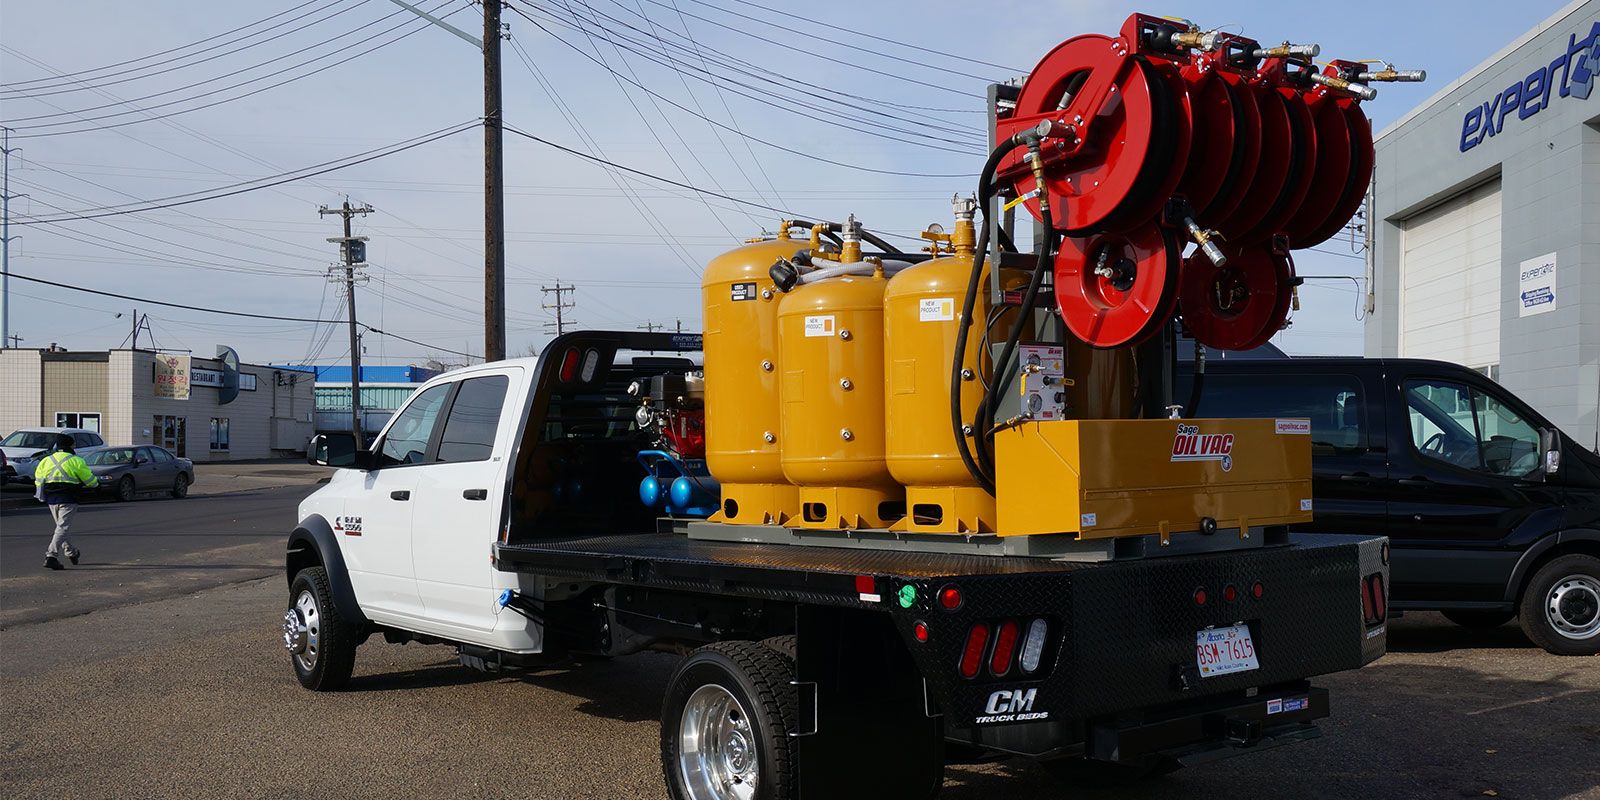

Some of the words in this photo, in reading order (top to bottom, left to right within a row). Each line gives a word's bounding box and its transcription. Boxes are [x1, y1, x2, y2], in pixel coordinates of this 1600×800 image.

[1177, 424, 1198, 435] Sage
[1172, 435, 1198, 455] OIL
[1200, 434, 1234, 455] VAC
[985, 688, 1038, 714] CM
[975, 714, 1016, 724] TRUCK
[1016, 711, 1049, 721] BEDS
